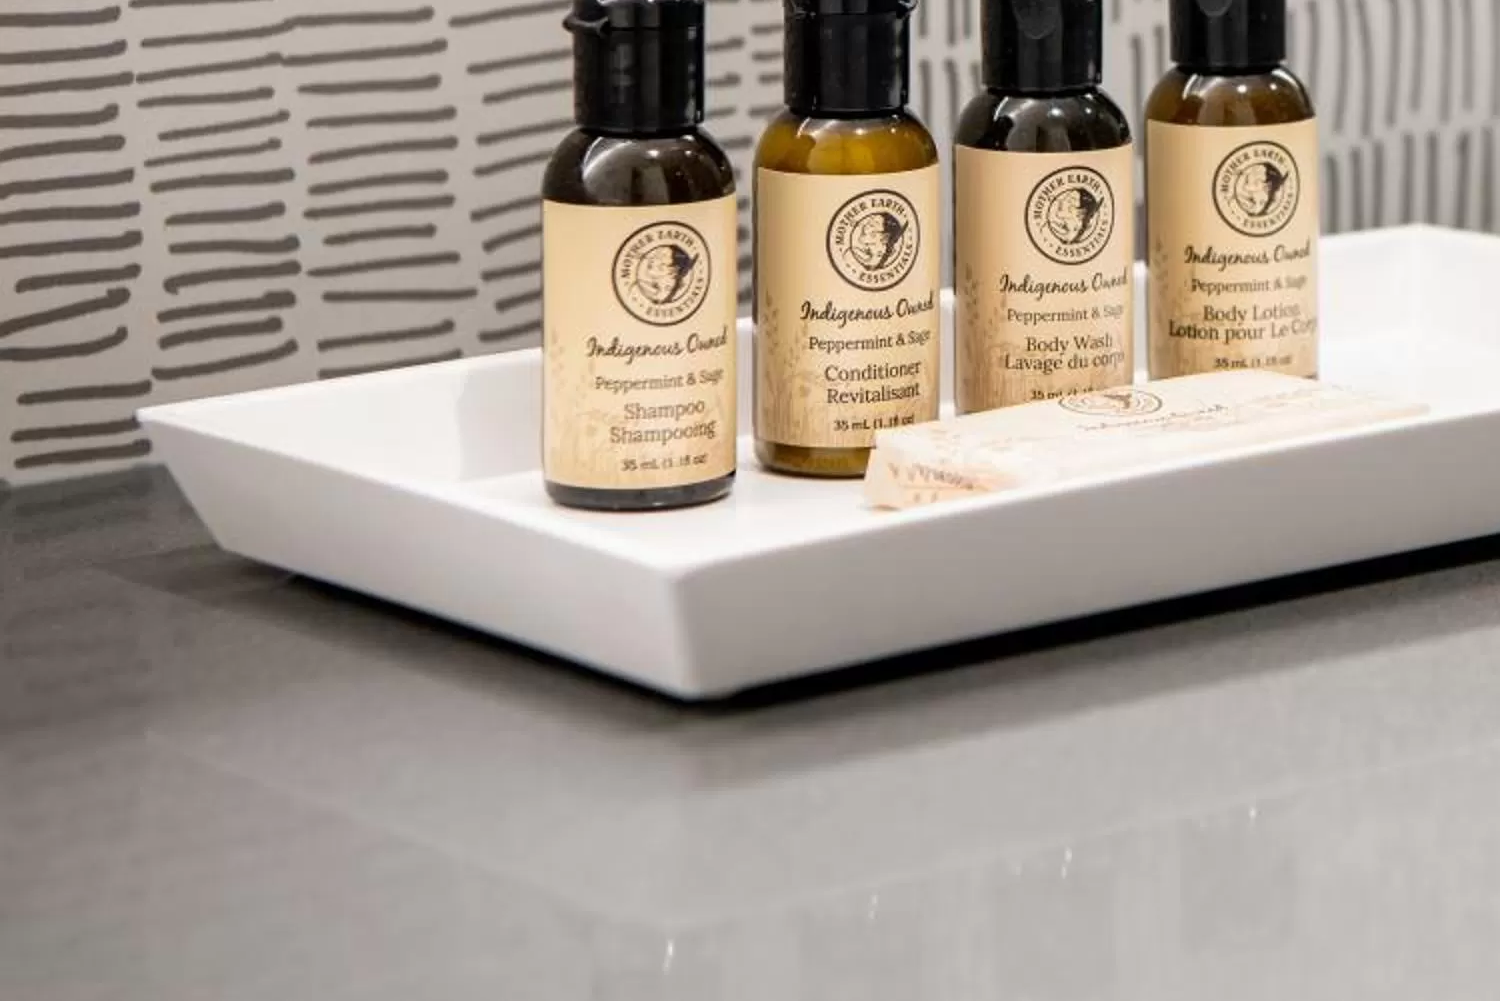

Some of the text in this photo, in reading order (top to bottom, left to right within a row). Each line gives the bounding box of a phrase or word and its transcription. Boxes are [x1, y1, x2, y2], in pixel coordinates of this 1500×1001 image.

[1033, 177, 1064, 219] MOTHER
[835, 198, 905, 246] MOTHER EARTH
[621, 230, 695, 279] MOTHER EARTH
[859, 244, 912, 284] ESSENTIALS
[1184, 244, 1270, 271] Indigenous
[999, 274, 1088, 301] Indigenous
[1191, 278, 1269, 296] Peppermint
[800, 290, 934, 328] Indigenous Owned
[1007, 308, 1087, 325] Peppermint
[1203, 305, 1247, 325] Body
[1168, 318, 1219, 340] Lotion
[1224, 326, 1266, 344] pour
[1271, 322, 1289, 339] Le
[587, 326, 728, 365] Indigenous Owned
[808, 335, 893, 354] Peppermint
[1026, 332, 1113, 355] Body Wash
[824, 361, 921, 382] Conditioner
[1005, 353, 1063, 374] Lavage
[1067, 354, 1088, 370] du
[596, 374, 684, 393] Peppermint
[827, 383, 920, 404] Revitalisant
[624, 400, 705, 421] Shampoo
[610, 420, 716, 445] Shampooing
[833, 420, 849, 431] 35
